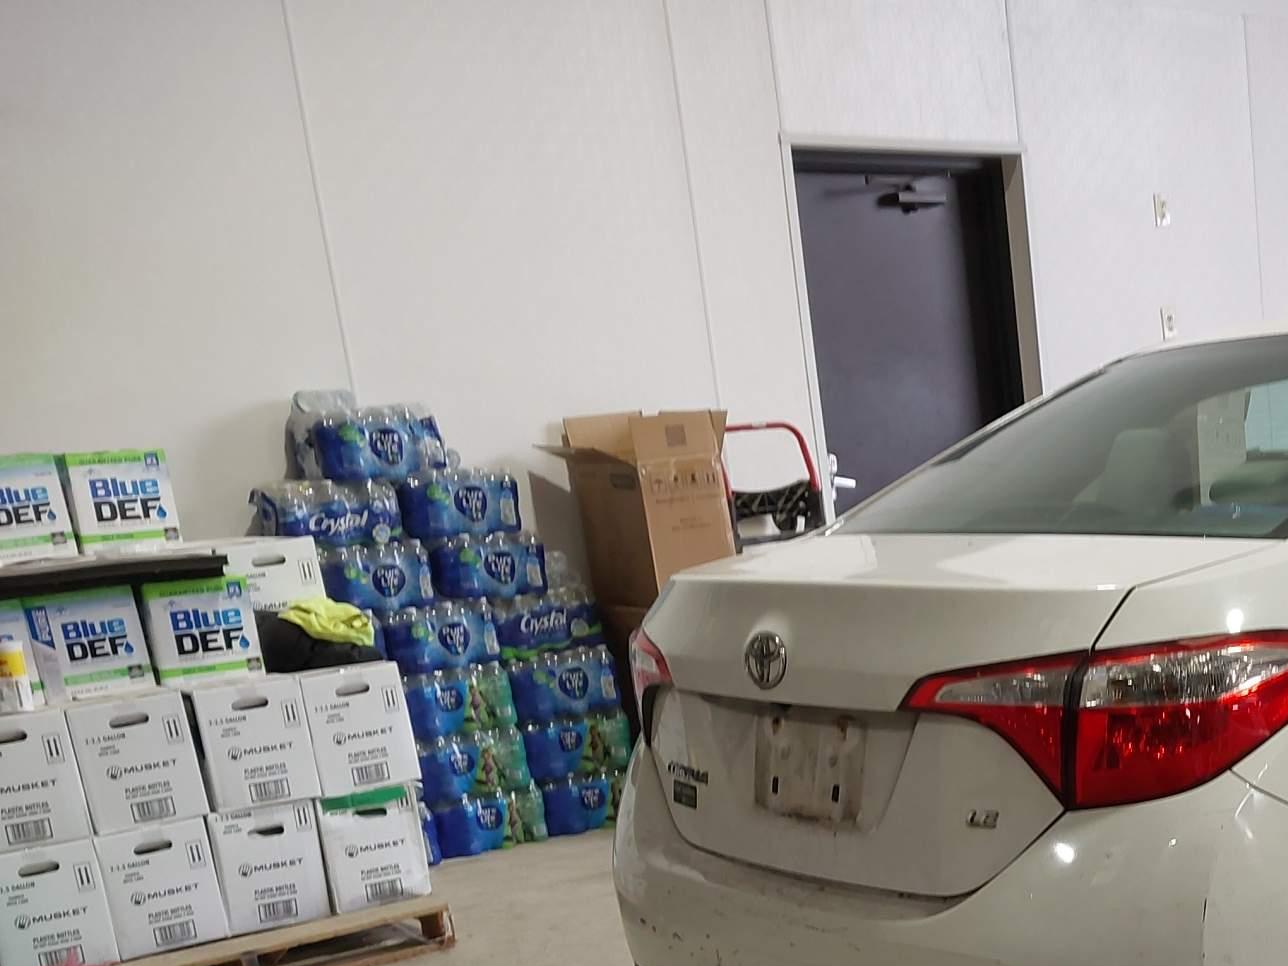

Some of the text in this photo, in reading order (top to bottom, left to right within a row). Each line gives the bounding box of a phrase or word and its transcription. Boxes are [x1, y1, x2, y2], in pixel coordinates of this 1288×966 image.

[0, 486, 49, 505] lue
[88, 477, 160, 499] Blue
[94, 497, 161, 522] DEF
[308, 510, 369, 535] Crystal
[61, 617, 126, 641] Blue
[170, 607, 242, 632] Blue
[66, 634, 128, 663] DEF
[175, 626, 243, 656] DEF
[347, 726, 394, 741] MUSKET
[243, 741, 294, 756] MUSKET
[123, 758, 177, 775] MUSKET
[0, 779, 57, 795] MUSKET
[358, 838, 406, 854] MUSKET
[253, 857, 304, 873] MUSKET
[147, 882, 200, 900] MUSKET
[31, 905, 89, 924] MUSKET
